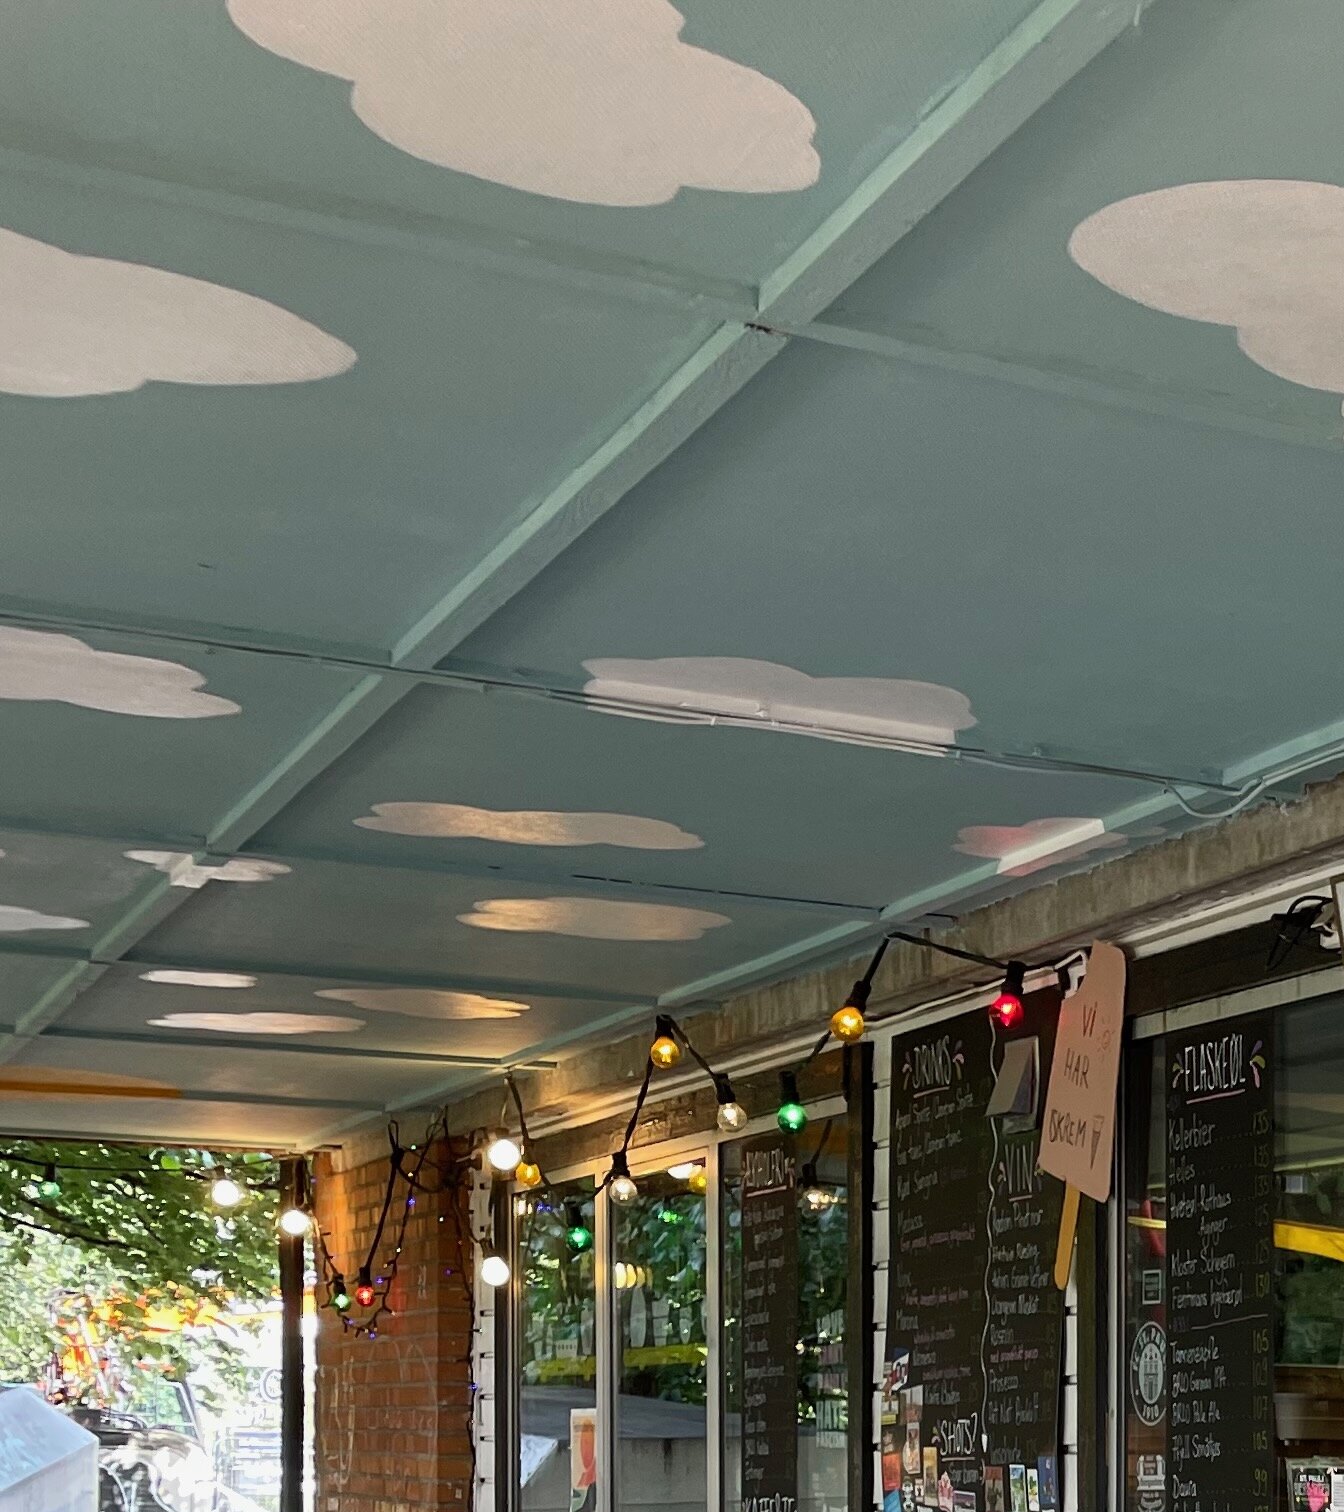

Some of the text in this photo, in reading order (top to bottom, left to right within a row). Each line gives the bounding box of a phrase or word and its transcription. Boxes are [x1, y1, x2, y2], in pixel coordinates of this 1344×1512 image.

[1063, 1047, 1090, 1090] HAR
[1184, 1032, 1247, 1094] FLASKEØL
[1004, 1140, 1034, 1196] VIN
